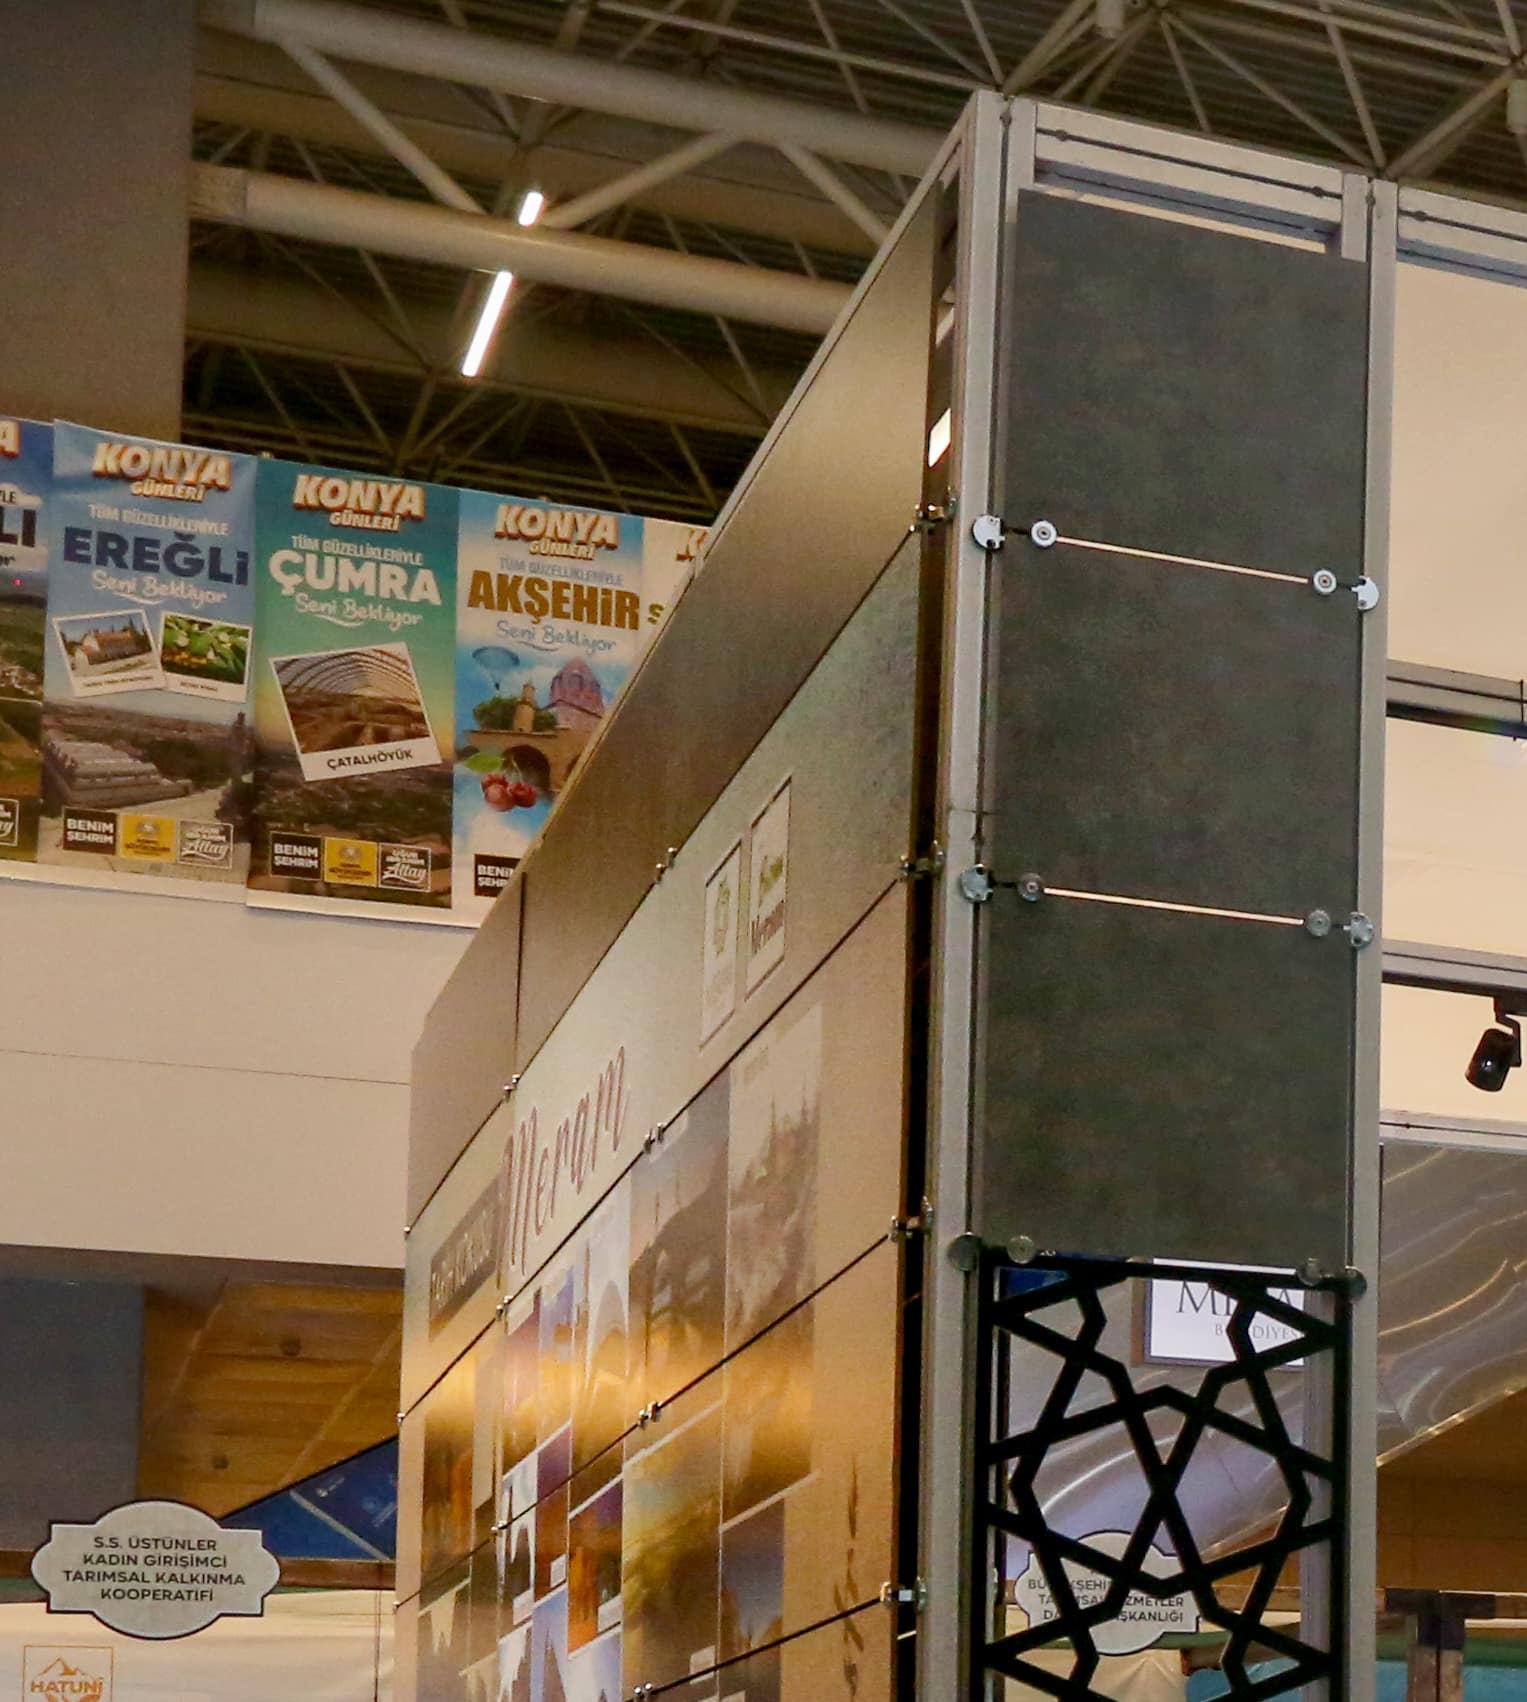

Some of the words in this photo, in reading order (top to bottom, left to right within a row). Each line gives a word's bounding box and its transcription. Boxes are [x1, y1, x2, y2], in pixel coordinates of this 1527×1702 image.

[92, 442, 232, 491] KONYA
[292, 473, 425, 521] KONYA
[494, 503, 620, 550] KONYA
[269, 549, 442, 606] ÇUMRA
[327, 748, 414, 771] ÇATALHÖYÜK
[83, 1553, 138, 1566] KADIN
[128, 1536, 217, 1551] ÜSTÜNLER
[63, 1569, 150, 1583] TARIMSAL
[155, 1571, 246, 1586] KALKINMA
